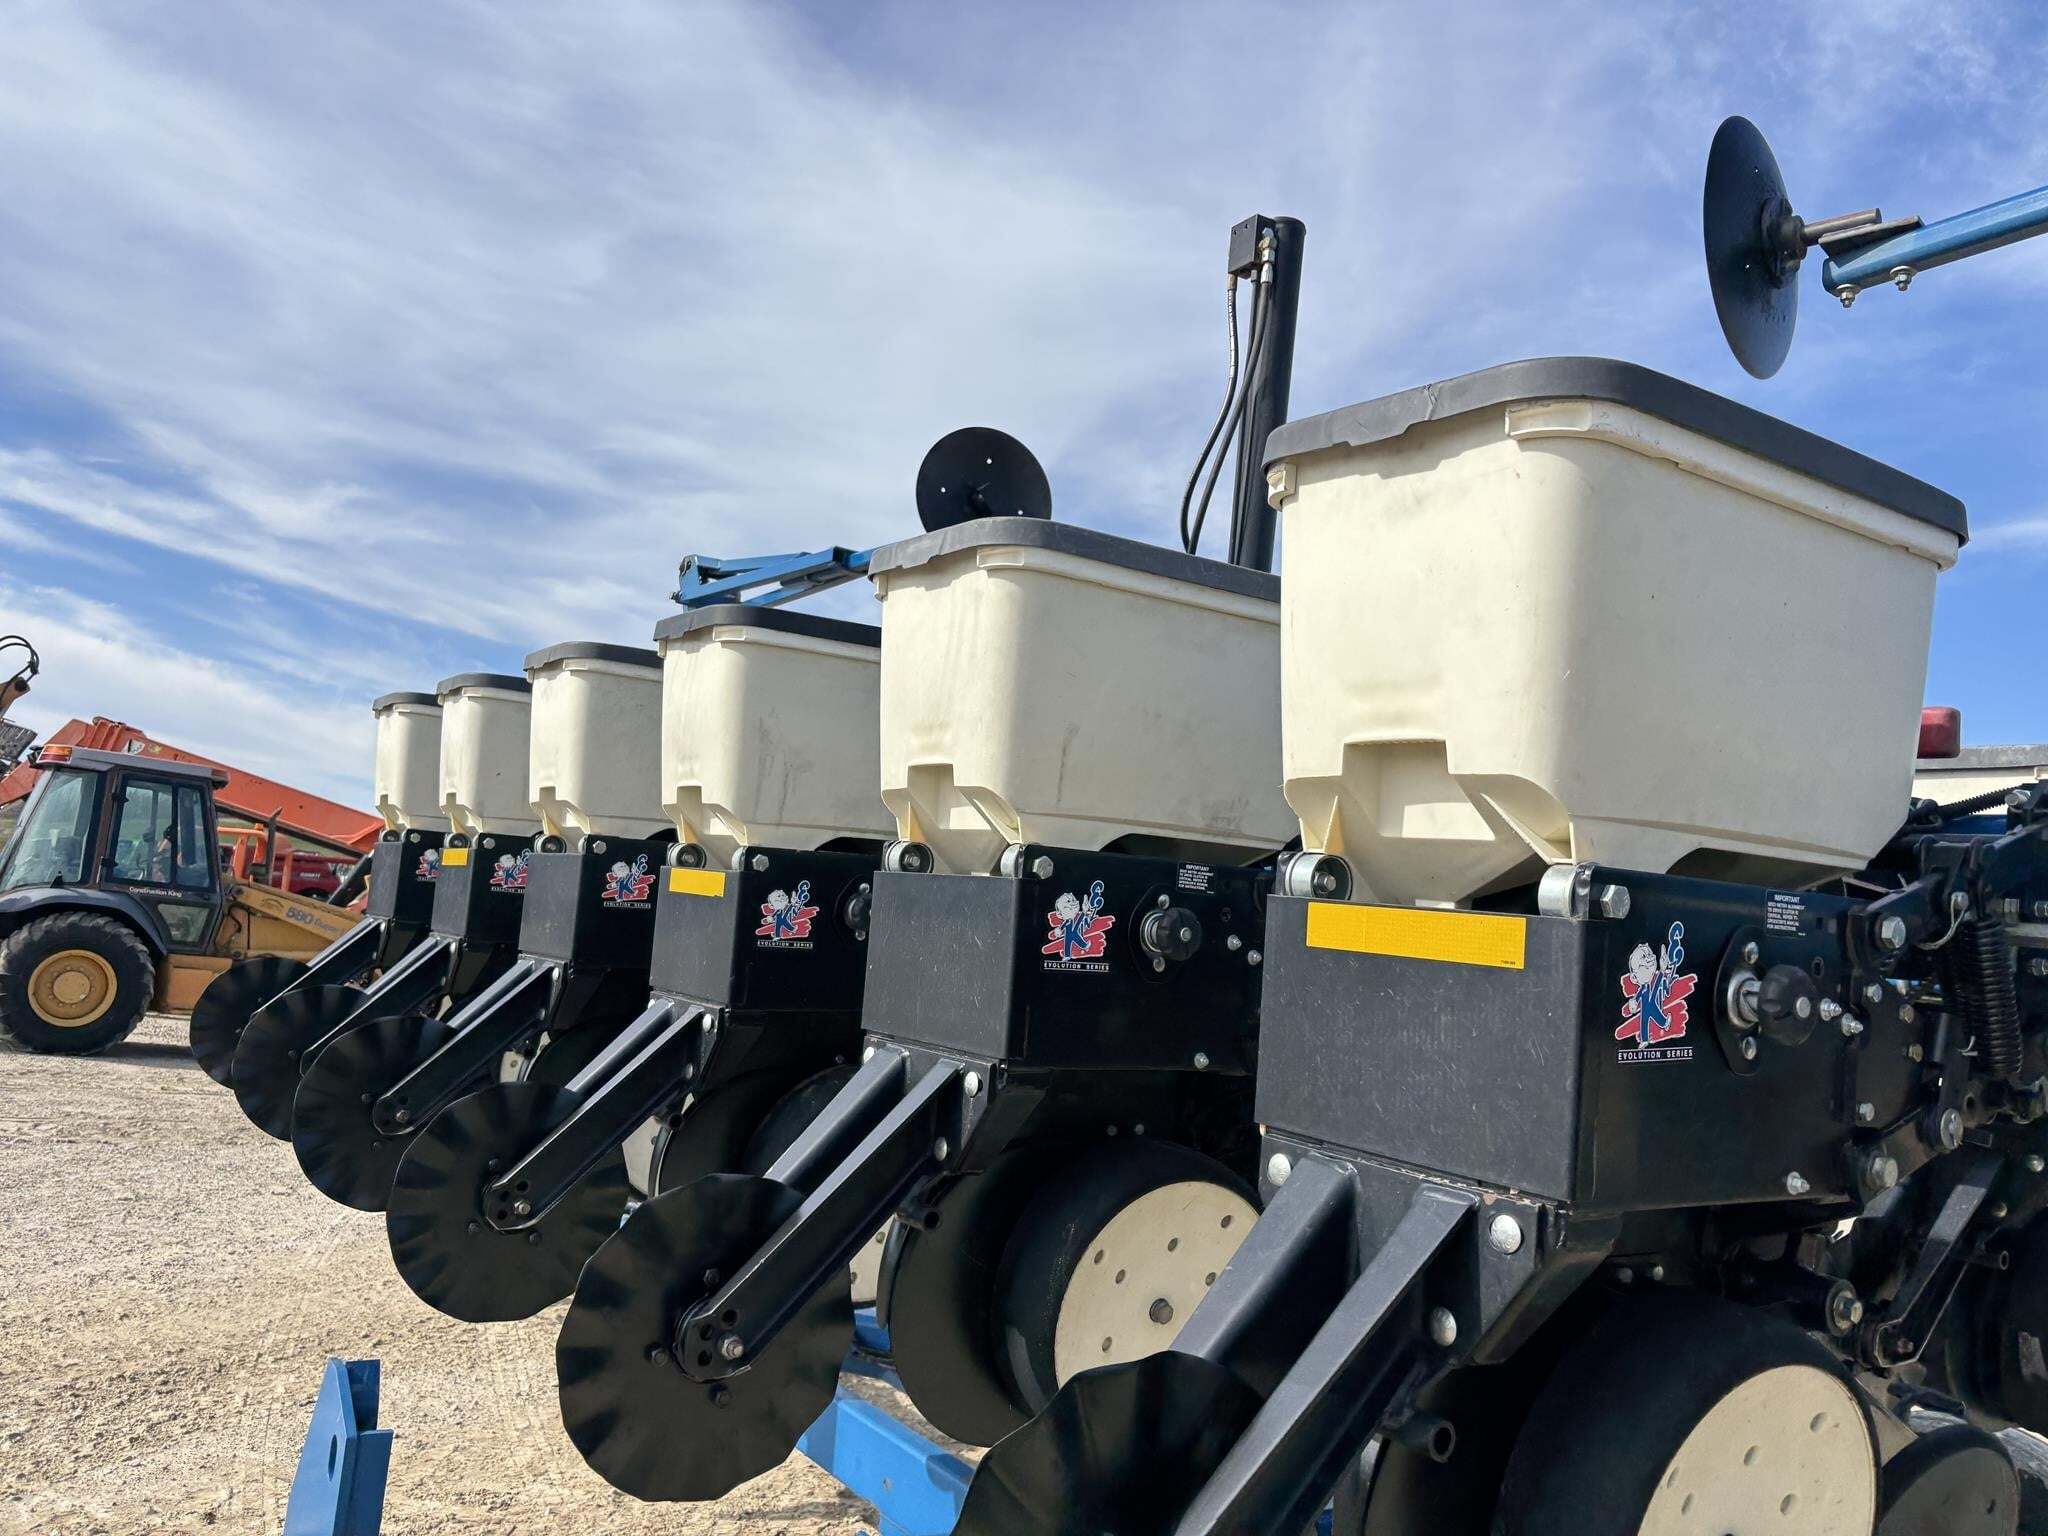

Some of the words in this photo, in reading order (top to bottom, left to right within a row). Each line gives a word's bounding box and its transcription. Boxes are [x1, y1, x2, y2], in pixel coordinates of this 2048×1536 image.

[129, 886, 167, 896] Construction
[167, 888, 183, 898] King
[286, 906, 314, 925] 580
[1043, 961, 1081, 969] EVOLUTION
[1618, 1050, 1661, 1061] EVOLUTION
[1666, 1049, 1693, 1058] SERIES
